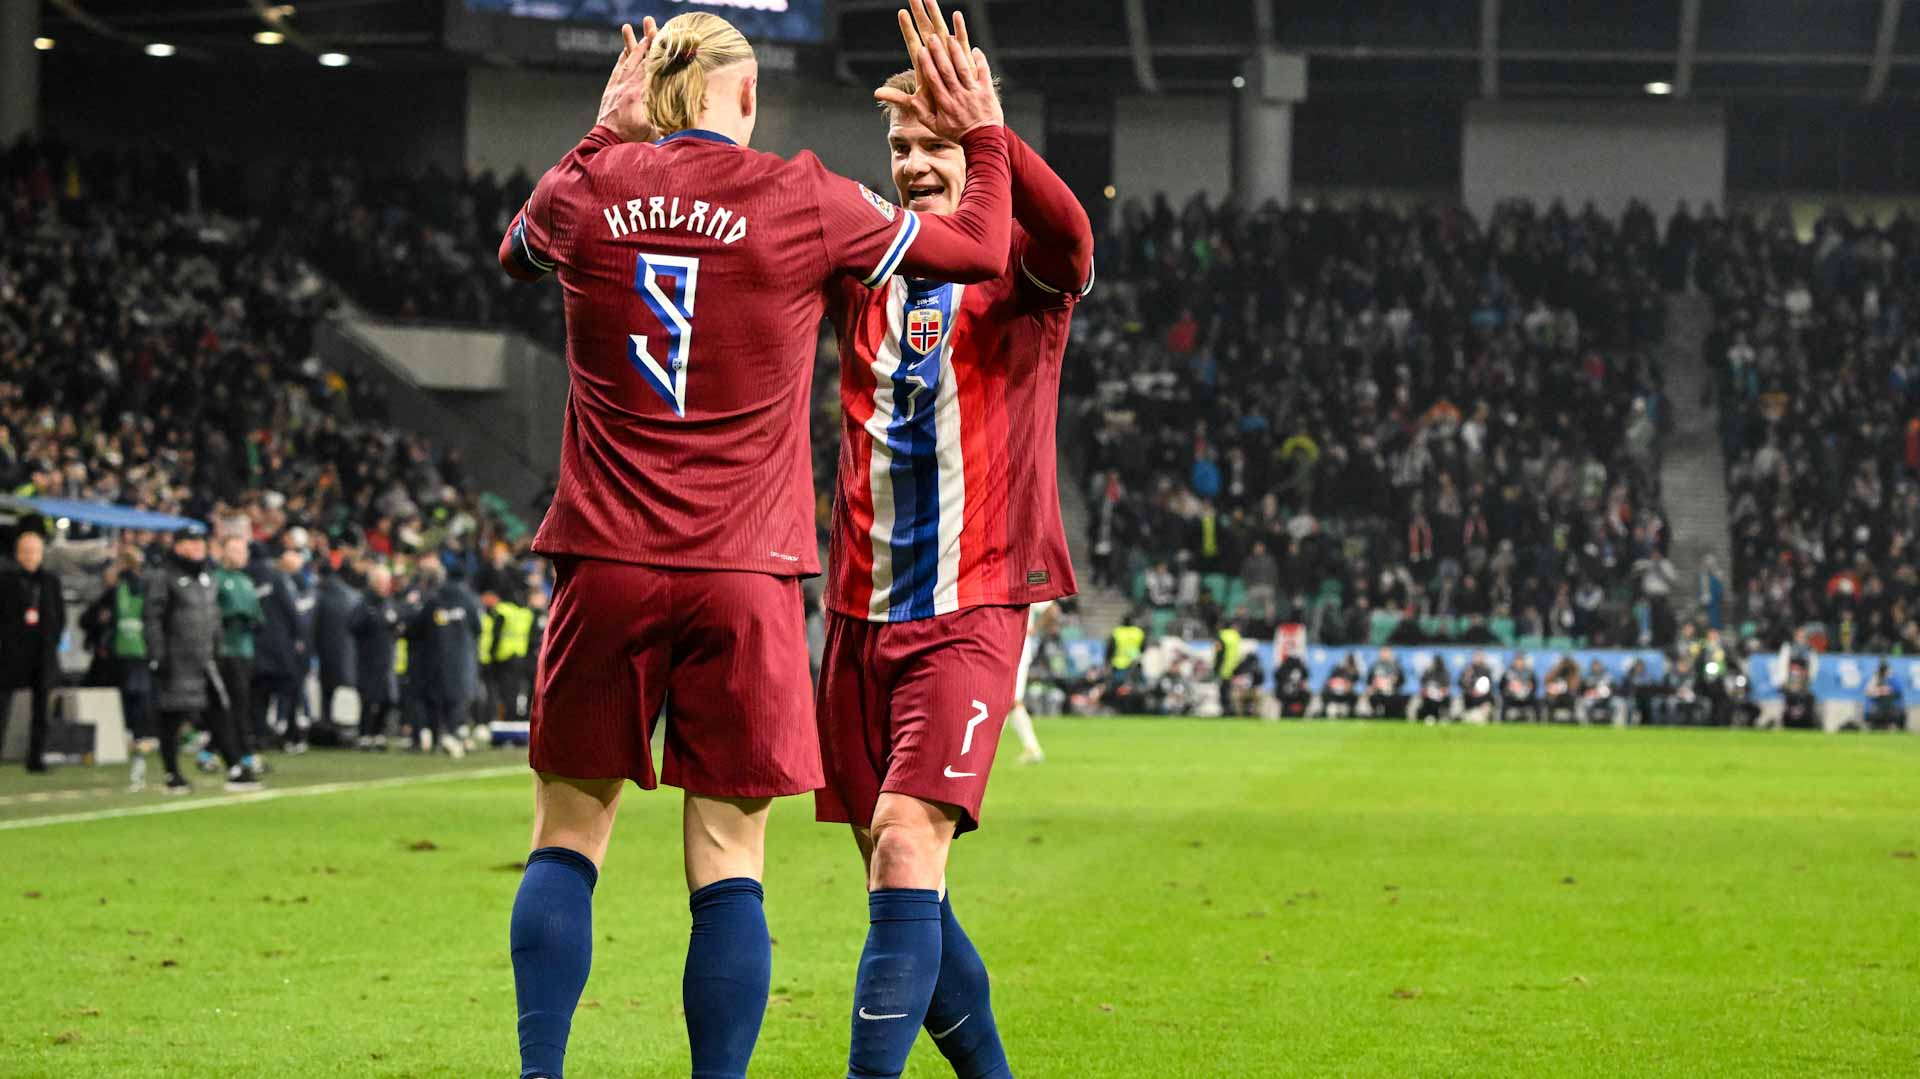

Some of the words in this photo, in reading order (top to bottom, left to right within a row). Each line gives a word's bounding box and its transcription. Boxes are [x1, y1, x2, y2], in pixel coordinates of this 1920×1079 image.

[604, 196, 746, 244] HAALAND
[628, 253, 699, 418] 9
[906, 376, 928, 422] 7
[961, 700, 988, 754] 7
